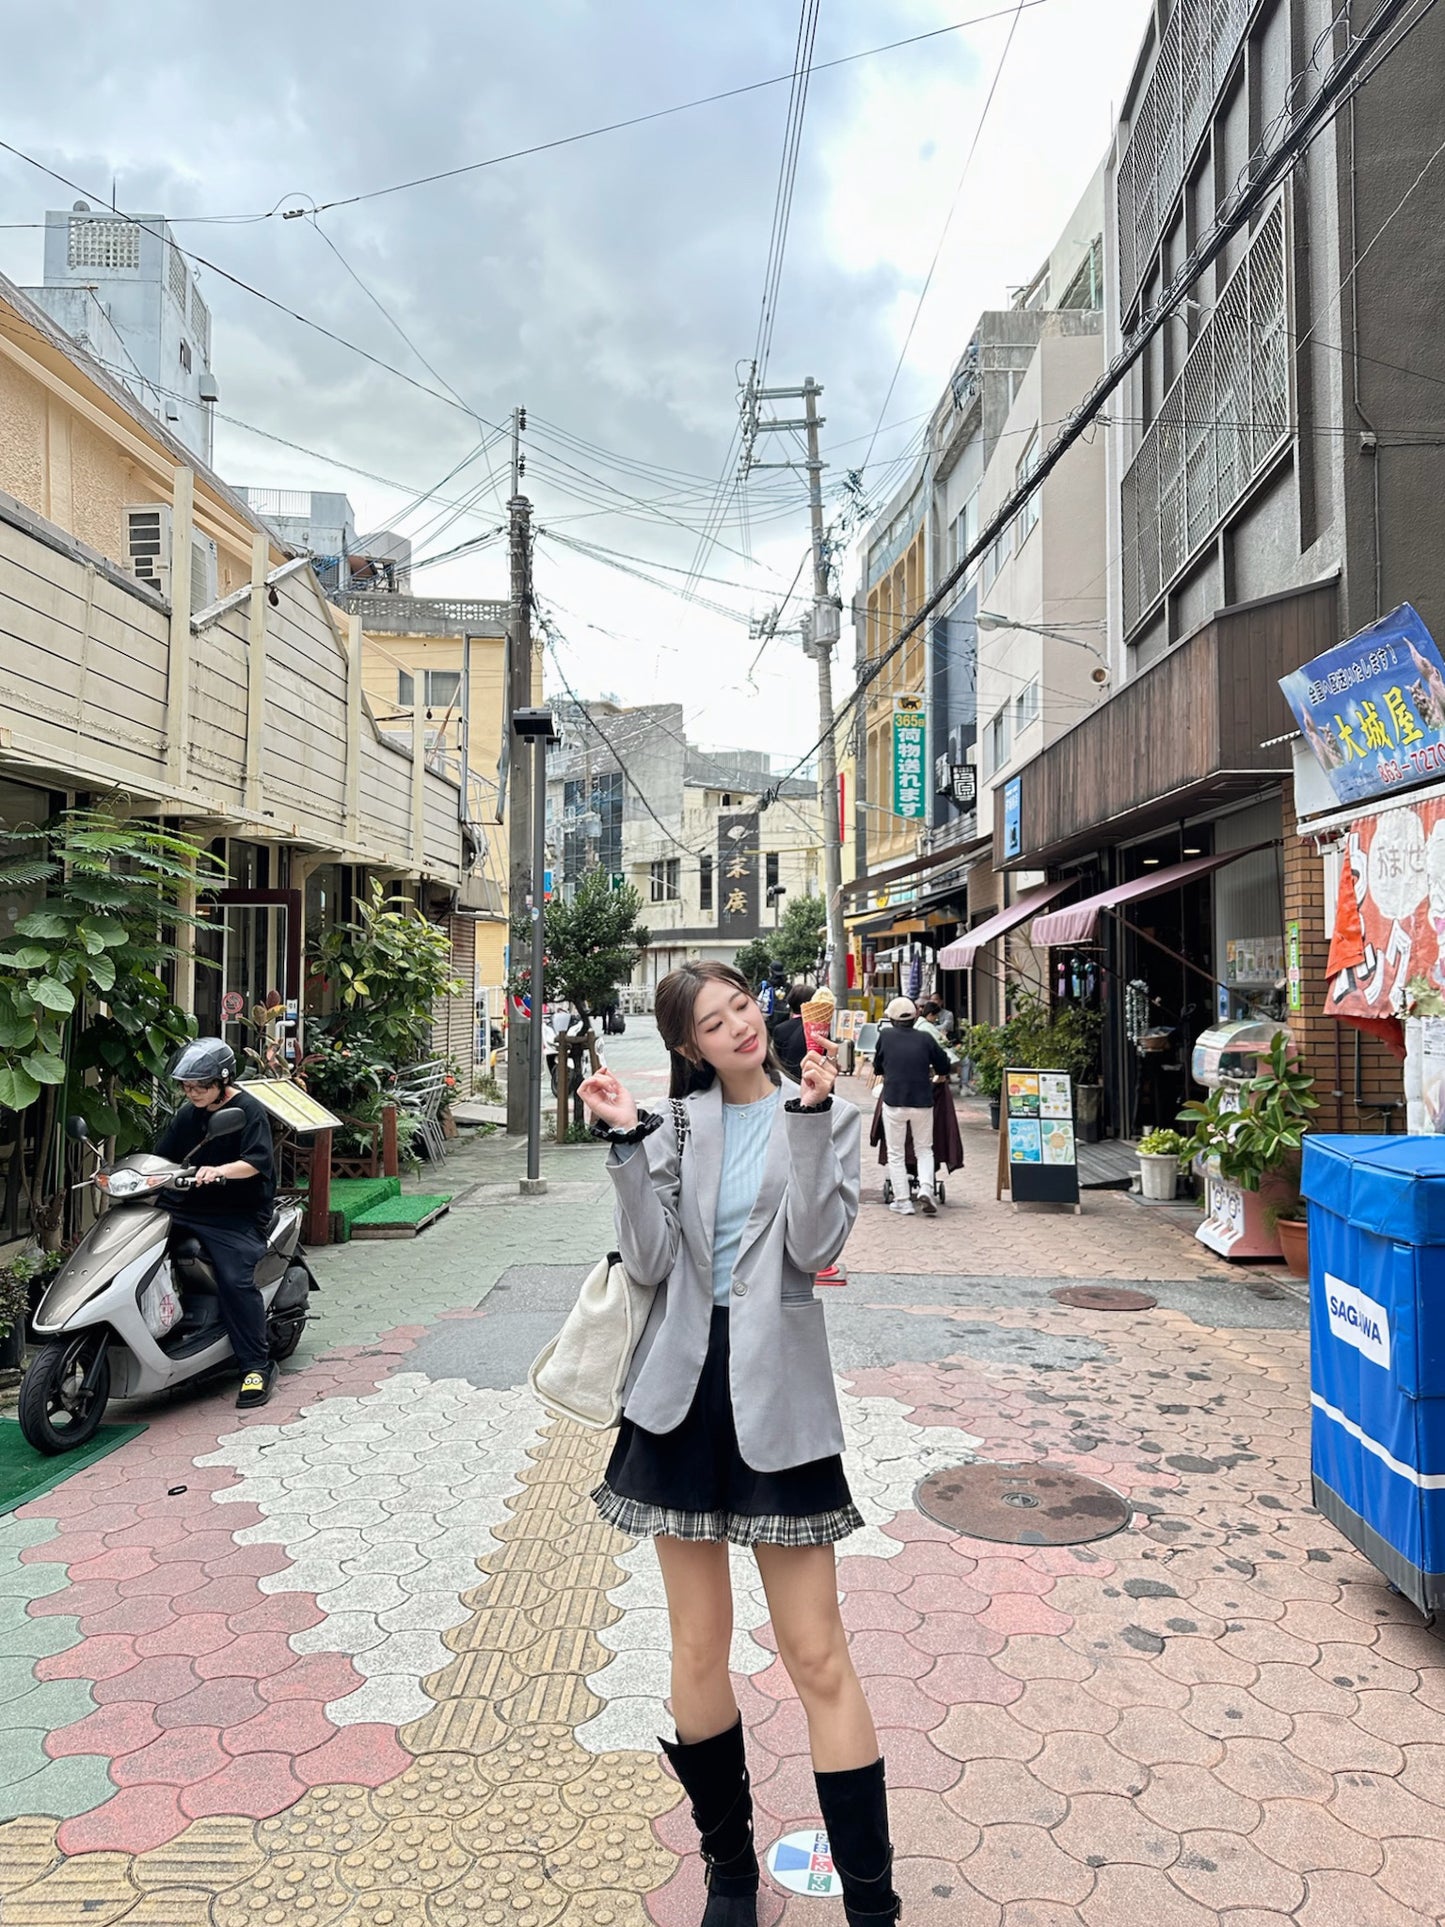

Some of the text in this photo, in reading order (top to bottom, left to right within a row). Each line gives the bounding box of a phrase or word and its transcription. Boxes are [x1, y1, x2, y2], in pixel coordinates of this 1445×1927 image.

[1334, 685, 1425, 763] 大城屋
[897, 727, 922, 817] 荷物送れます
